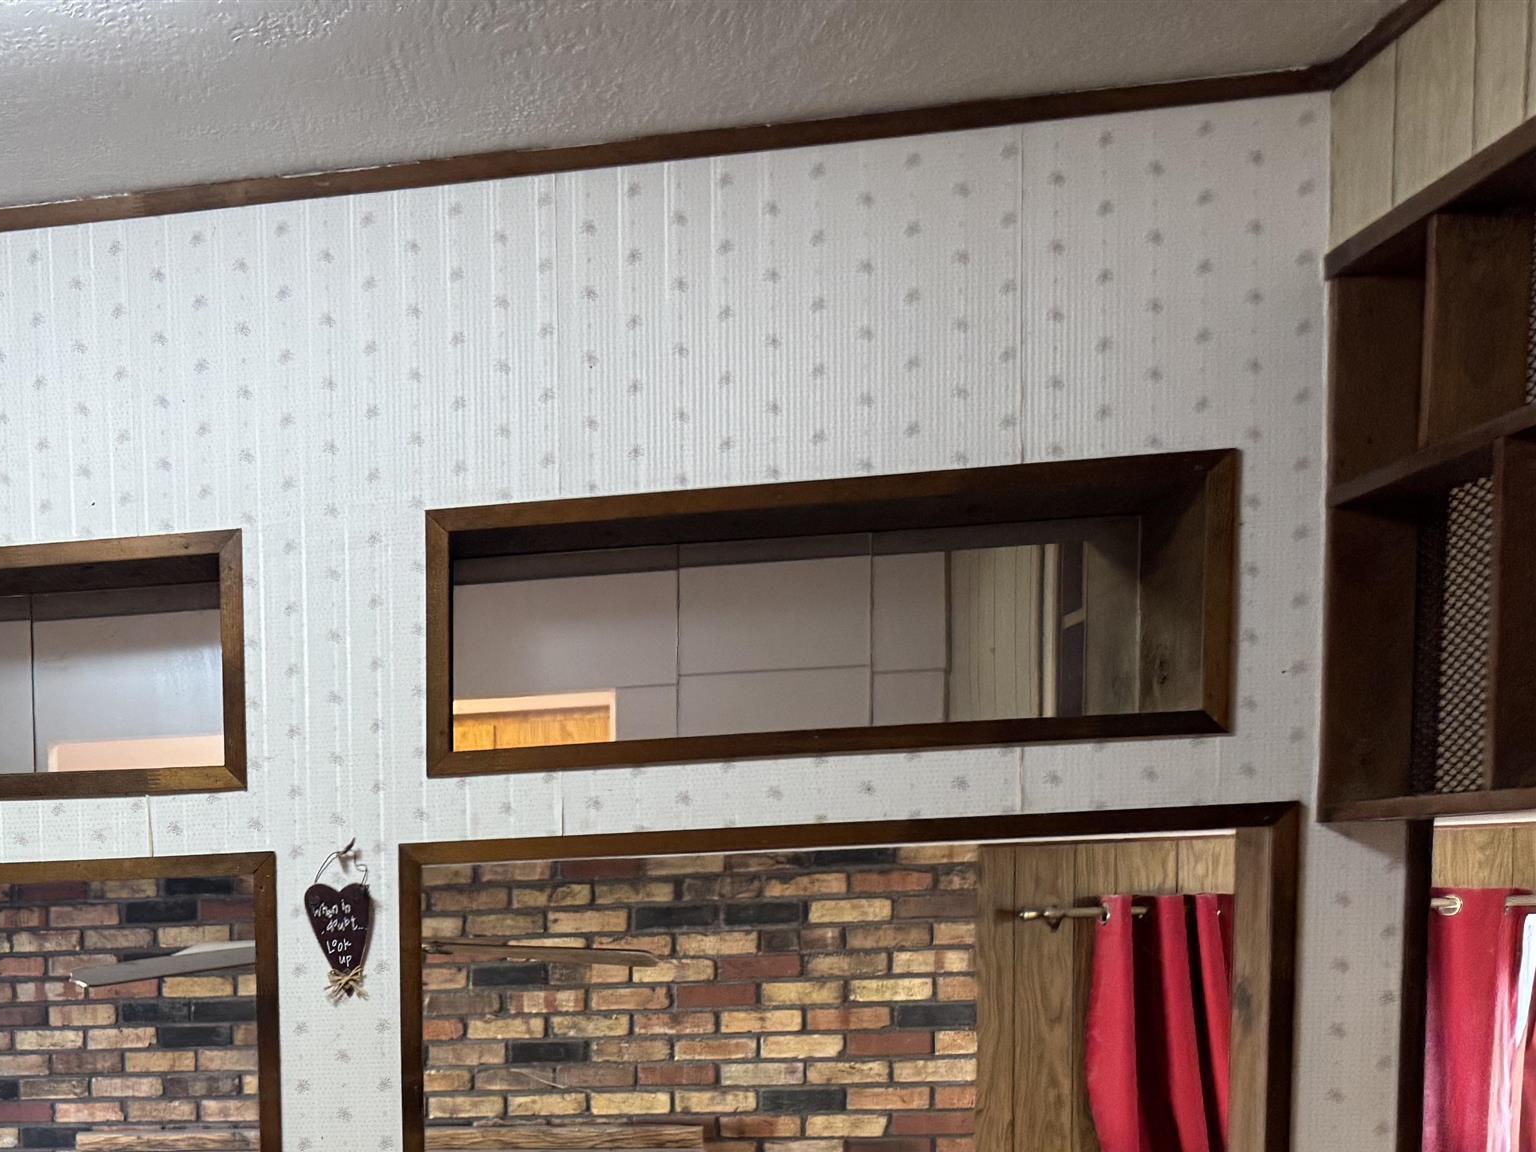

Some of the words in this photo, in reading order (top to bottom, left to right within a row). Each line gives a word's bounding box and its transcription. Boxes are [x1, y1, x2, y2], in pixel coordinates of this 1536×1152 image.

[340, 898, 352, 914] in
[326, 937, 352, 954] Look
[338, 955, 353, 968] up
